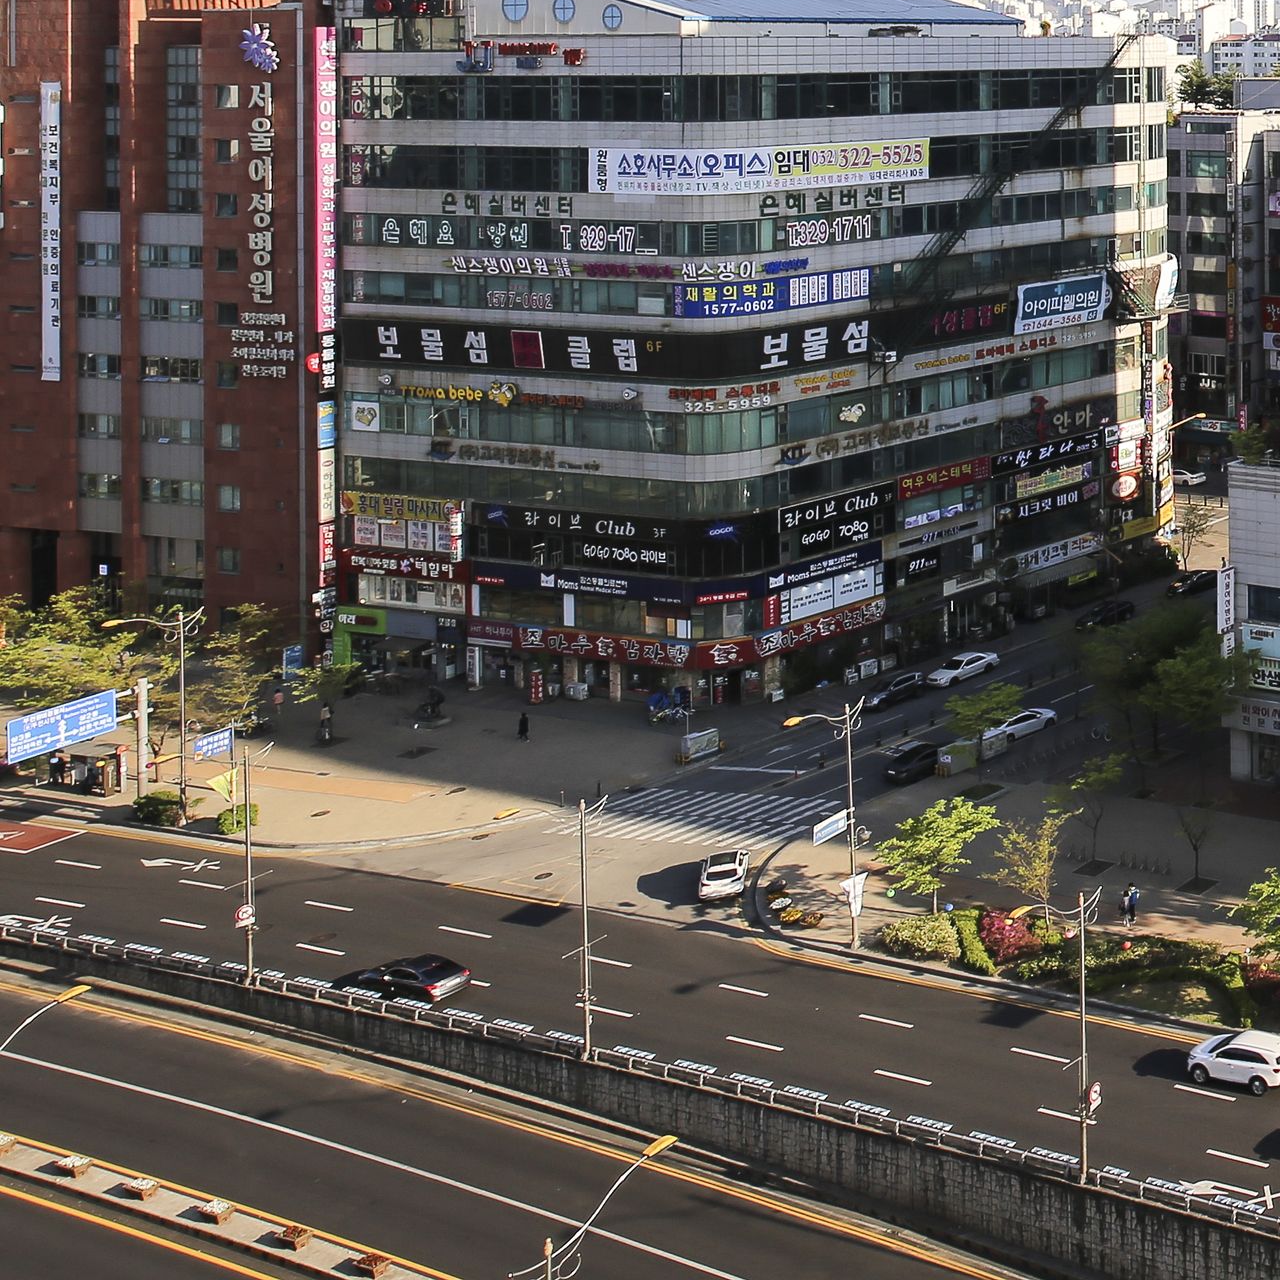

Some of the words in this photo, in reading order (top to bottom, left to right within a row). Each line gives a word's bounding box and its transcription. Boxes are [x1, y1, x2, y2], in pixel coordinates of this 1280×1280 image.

[774, 149, 810, 174] 임대
[839, 143, 924, 169] 322-5525
[248, 82, 274, 304] 서울여성병원
[441, 191, 573, 218] 은혜실버센터
[760, 184, 906, 217] 은혜실버센터
[451, 256, 549, 275] 센스쟁이의원
[682, 261, 757, 281] 센스쟁이
[686, 282, 775, 302] 재활의학과
[1024, 289, 1100, 316] 아이피웰의원
[994, 304, 1008, 315] 6F
[1032, 314, 1082, 330] 1644-3568
[377, 325, 488, 364] 보물섬
[568, 335, 638, 372] 클럽
[646, 341, 663, 353] 6F
[760, 320, 869, 370] 보물섬
[321, 333, 335, 389] 동물병원
[684, 395, 772, 413] 325-5959
[1053, 403, 1093, 434] 안마
[358, 495, 380, 513] 홍대
[383, 497, 405, 517] 힐링
[407, 499, 441, 519] 마사지
[785, 499, 838, 528] 라이브
[844, 492, 878, 513] Club
[1018, 497, 1052, 518] 시크릿
[1057, 490, 1078, 507] 비어
[524, 511, 582, 530] 라이브
[595, 520, 636, 537] Club
[801, 528, 831, 545] GOGO
[838, 520, 869, 537] 7080
[921, 529, 938, 544] 911
[584, 544, 610, 560] GOGO
[612, 547, 638, 563] 7080
[641, 549, 667, 564] 라이브
[909, 558, 925, 572] 911
[558, 578, 579, 591] Moms
[787, 571, 810, 583] Moms
[760, 622, 818, 658] 조마루
[836, 598, 886, 630] 감자탕
[521, 627, 593, 655] 조마루
[619, 639, 690, 665] 감자탕
[1251, 668, 1280, 689] 한샘
